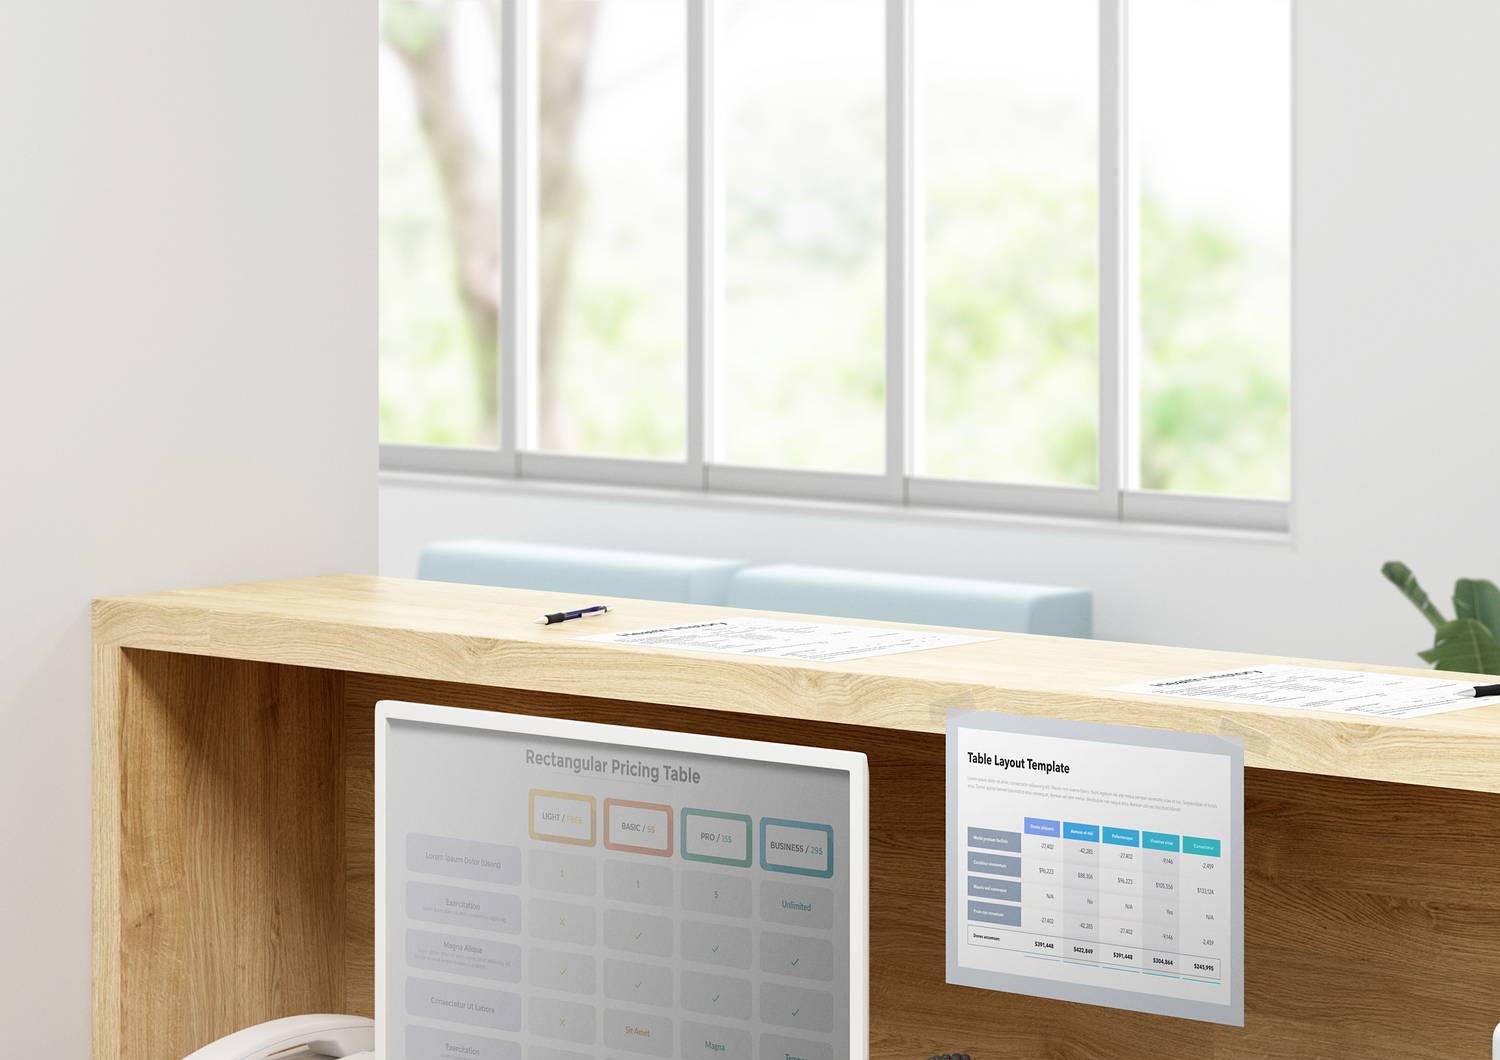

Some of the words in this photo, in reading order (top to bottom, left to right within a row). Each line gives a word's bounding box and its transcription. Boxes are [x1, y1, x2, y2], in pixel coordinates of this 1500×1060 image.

[526, 749, 608, 773] Rectangular
[612, 760, 659, 782] Pricing
[663, 765, 701, 784] Table
[967, 752, 992, 765] Table
[994, 755, 1025, 770] Layout
[1027, 759, 1070, 775] Template
[542, 812, 561, 822] LIGHT
[621, 822, 641, 832] BASIC
[700, 832, 715, 842] PRO
[770, 841, 804, 853] BUSINESS
[782, 900, 812, 912] Unlimited
